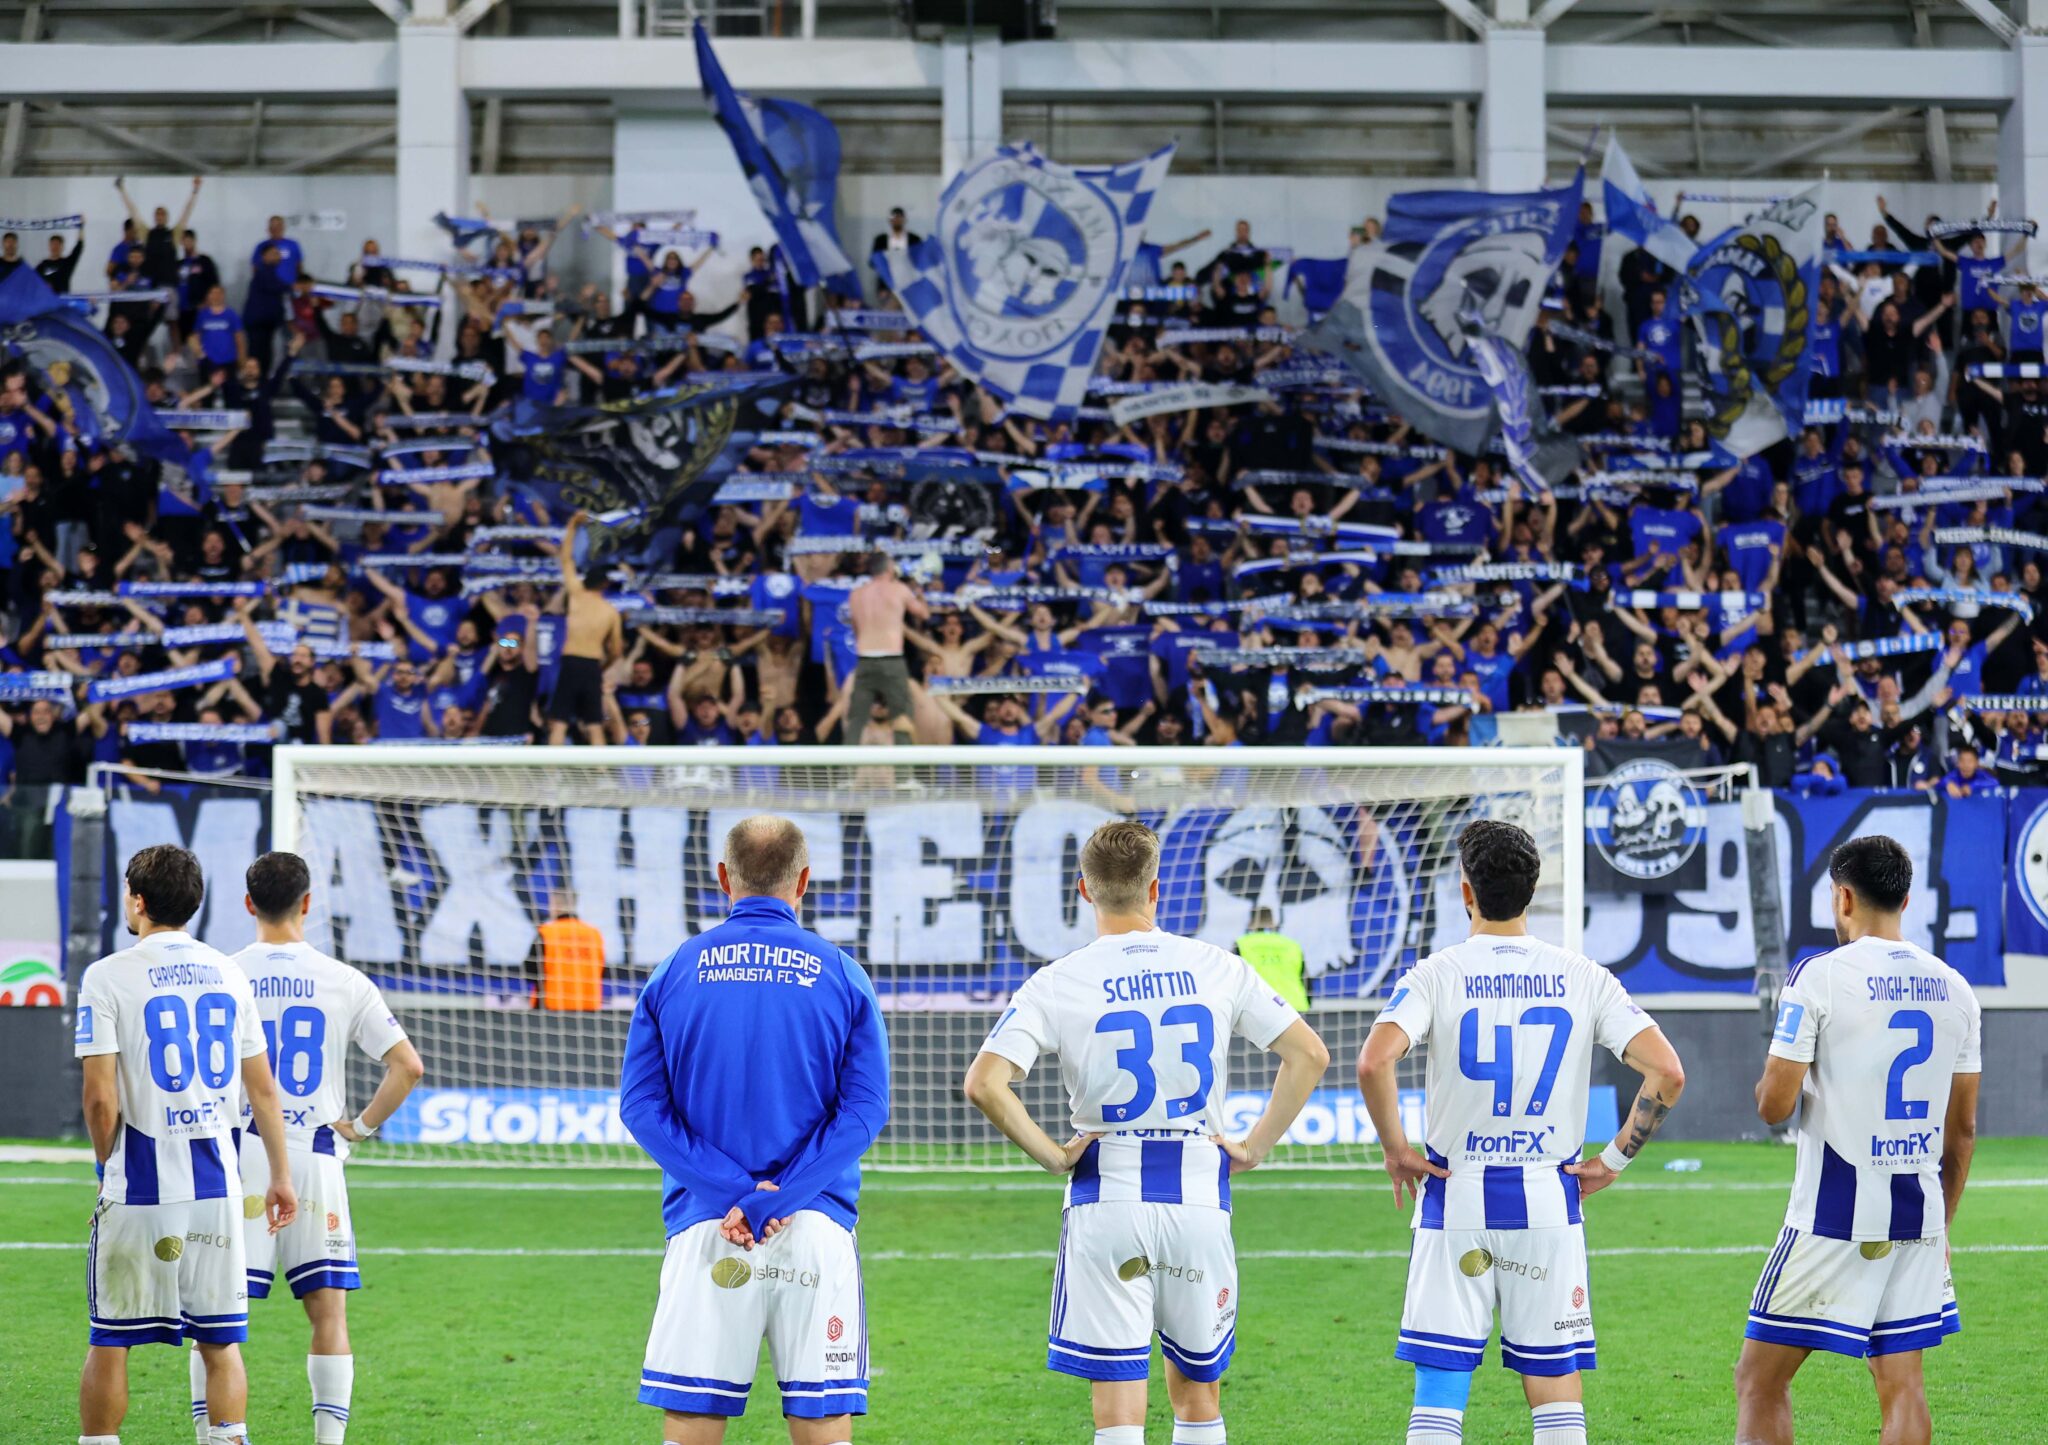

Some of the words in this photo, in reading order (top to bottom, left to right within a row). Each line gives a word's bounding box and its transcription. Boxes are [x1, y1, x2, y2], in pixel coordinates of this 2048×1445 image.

[697, 943, 822, 975] ANORTHOSIS
[250, 976, 314, 998] OANNOU
[699, 968, 773, 983] FAMAGUSTA
[777, 970, 794, 983] FC
[1103, 969, 1197, 1003] SCHÄTTIN
[1465, 973, 1565, 999] KARAMANOLIS
[1867, 976, 1950, 1002] SINGH-THANDI
[144, 993, 237, 1093] 88
[1095, 1003, 1215, 1122] 33
[1459, 1006, 1574, 1117] 47
[1885, 1009, 1934, 1120] 2
[166, 1102, 218, 1127] IronF
[418, 1091, 639, 1145] Stoixi
[1466, 1131, 1546, 1154] IronFX
[1872, 1133, 1932, 1156] IronFX
[215, 1235, 231, 1249] Oil
[753, 1264, 796, 1283] Island
[799, 1271, 820, 1288] Oil
[1186, 1269, 1204, 1284] Oil
[1493, 1256, 1528, 1276] sland
[1530, 1266, 1548, 1281] Oil
